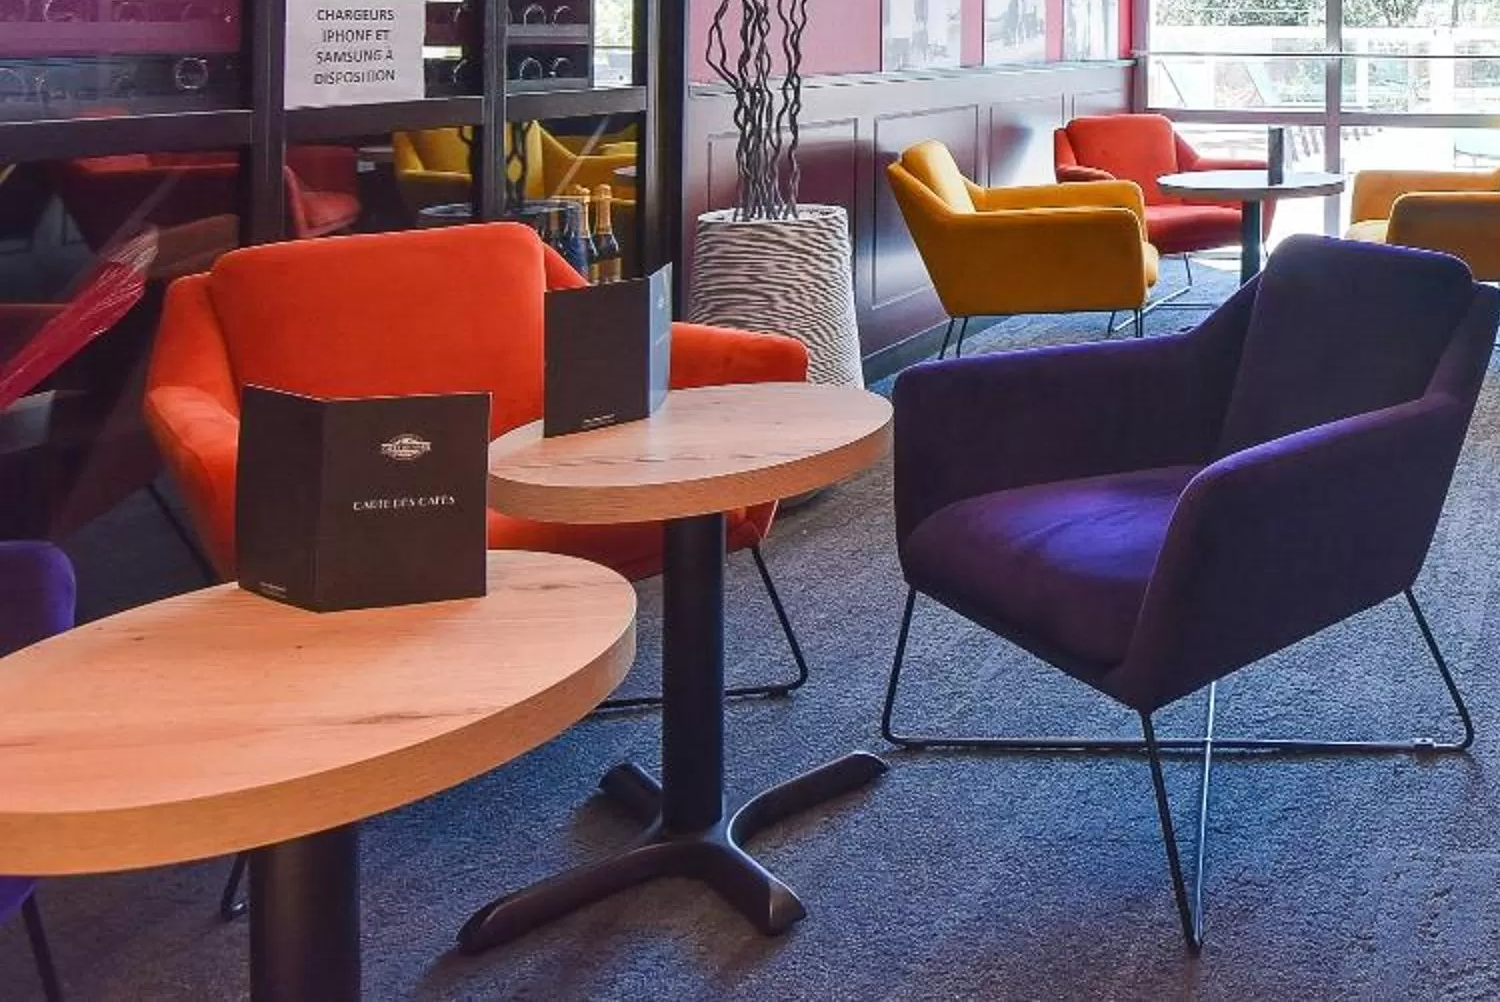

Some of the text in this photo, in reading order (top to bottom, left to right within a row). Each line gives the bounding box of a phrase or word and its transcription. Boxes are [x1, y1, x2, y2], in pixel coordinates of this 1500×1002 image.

[316, 9, 395, 21] CHARGEURS
[376, 29, 390, 41] ET
[316, 50, 382, 64] SAMSUNG
[314, 69, 395, 85] DISPOSITION
